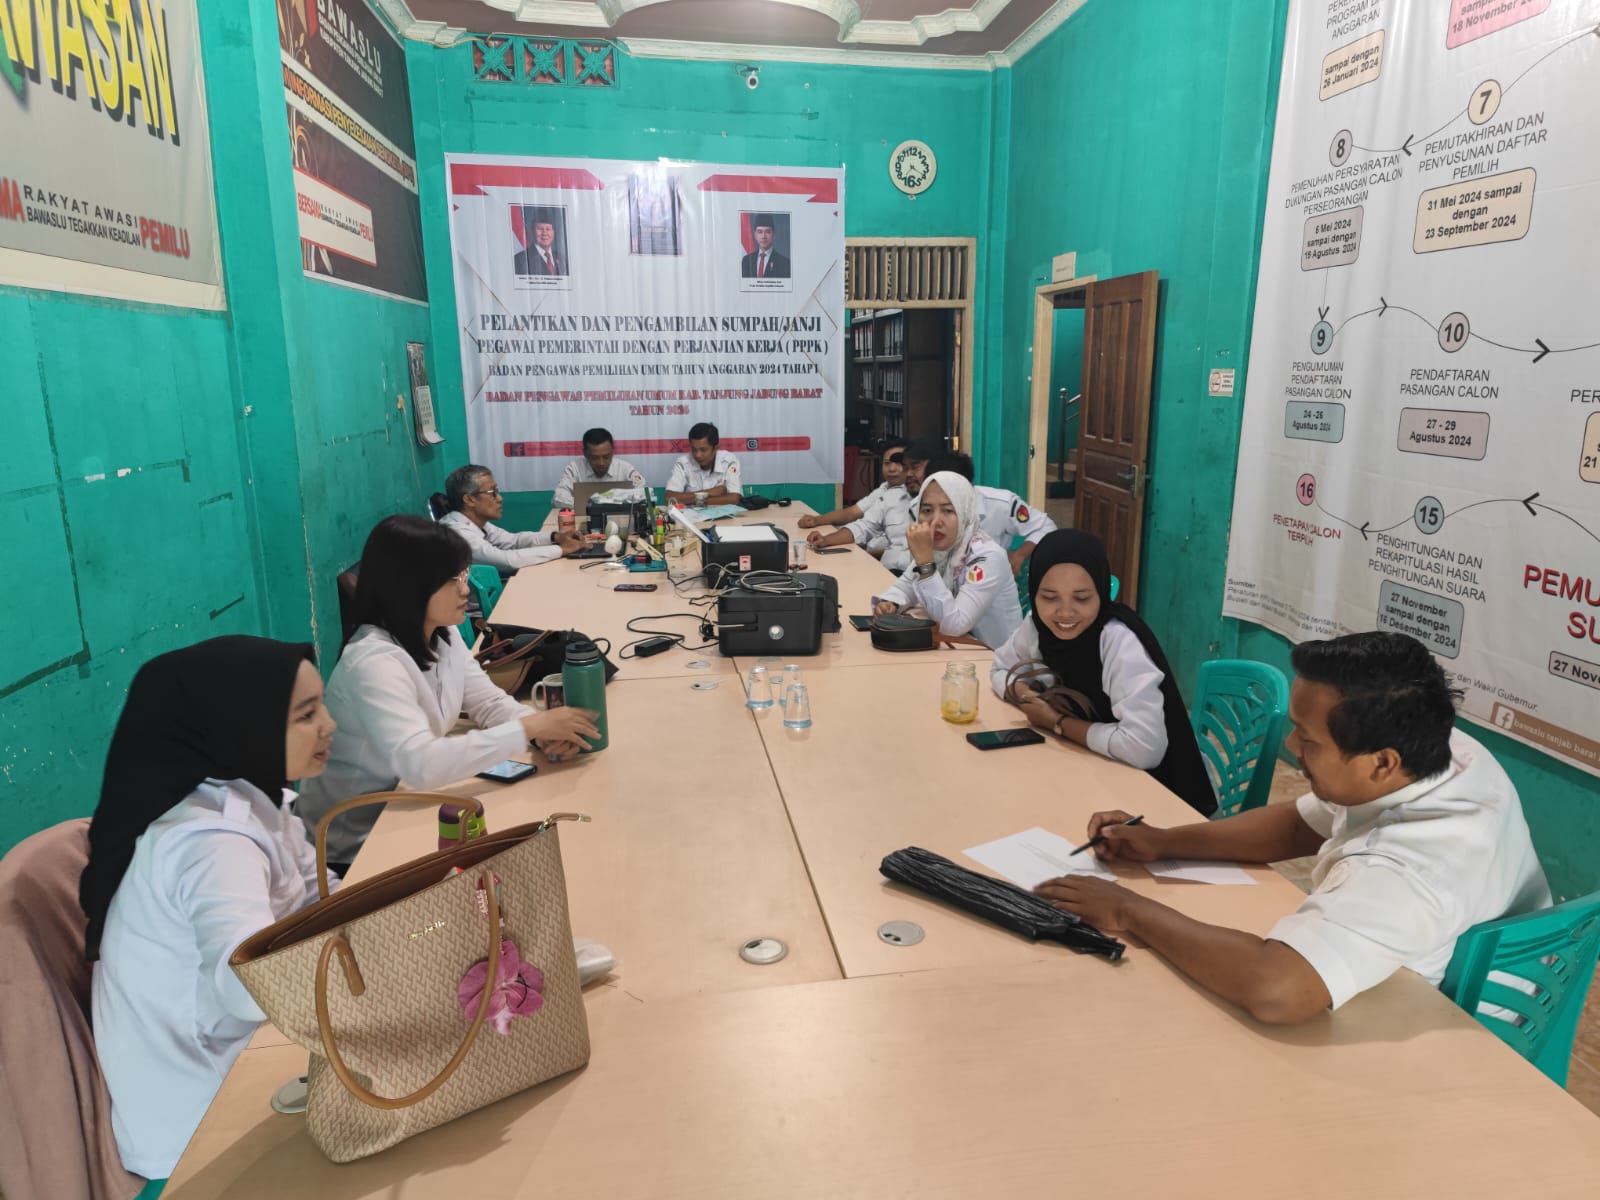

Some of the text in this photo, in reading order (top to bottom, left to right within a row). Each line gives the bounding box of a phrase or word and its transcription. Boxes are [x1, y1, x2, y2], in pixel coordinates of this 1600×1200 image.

[1332, 8, 1380, 40] ANGGARAN
[1452, 23, 1463, 33] 18
[1465, 0, 1517, 28] November
[1325, 46, 1380, 75] sampai dengan
[1332, 65, 1359, 85] Januari
[1360, 57, 1379, 73] 2024
[1480, 89, 1492, 115] 7
[1425, 111, 1545, 155] PEMUTAKHIRAN DAN
[1336, 138, 1346, 158] 8
[1419, 129, 1548, 173] PENYUSUNAN DAFTAR
[1291, 153, 1400, 194] PEMENUHAN PERSYARATAN
[1453, 158, 1499, 180] PEMILIH
[1285, 167, 1403, 208] DUKUNGAN PASANGAN CALON
[1427, 182, 1522, 211] 31 Mei 2024 sampai
[23, 184, 138, 228] RAKYAT AWASI
[1303, 190, 1368, 215] PERSEORANGAN
[1452, 206, 1488, 220] dengan
[27, 206, 141, 246] BAWASLU TEGAKKAN KEADILAN
[1321, 222, 1333, 233] Mei
[1334, 218, 1352, 230] 2024
[1425, 214, 1516, 239] 23 September 2024
[139, 216, 190, 259] PEMILU
[1307, 232, 1356, 247] sampai dengan
[1312, 247, 1340, 260] Agustus
[480, 314, 821, 332] PELANTIKAN DAN PENGAMBILAN SUMPAH/JANJI
[1316, 322, 1464, 347] 9 10
[478, 339, 535, 353] PEGAWAI
[538, 339, 619, 353] PEMERINTAH
[622, 339, 670, 353] DENGAN
[674, 339, 745, 353] PERJANJIAN
[747, 339, 783, 353] KERJA
[488, 365, 522, 376] BADAN
[525, 365, 580, 376] PENGAWAS
[582, 364, 638, 376] PEMILIHAN
[641, 364, 669, 375] UMUM
[672, 364, 705, 375] TAHUN
[708, 364, 757, 375] ANGGARAN
[759, 363, 781, 374] 2024
[783, 363, 812, 374] TAHAP
[1292, 361, 1344, 372] PENGUMUMAN
[1410, 368, 1490, 381] PENDAFTARAN
[1291, 375, 1342, 384] PENDAFTARAN
[485, 391, 522, 402] BADAN
[524, 391, 582, 402] PENGAWAS
[584, 390, 643, 401] PEMILIHAN
[646, 390, 677, 400] UMUM
[703, 389, 748, 400] TANJUNG
[750, 389, 788, 399] JABUNG
[790, 388, 823, 399] BARAT
[1285, 387, 1351, 399] PASANGAN CALON
[1400, 383, 1499, 399] PASANGAN CALON
[629, 405, 665, 415] TAHUN
[1292, 420, 1318, 431] Agustus
[1426, 419, 1437, 429] 27
[1409, 431, 1472, 446] Agustus 2024
[1583, 456, 1597, 468] 21
[1300, 481, 1314, 498] 16
[1420, 505, 1439, 525] 15
[1377, 533, 1483, 569] PENGHITUNGAN DAN
[1376, 547, 1479, 585] REKAPITULASI HASIL
[1368, 558, 1486, 603] PENGHITUNGAN SUARA
[1523, 564, 1600, 607] PEMU
[1391, 592, 1447, 617] 27 November
[1386, 604, 1450, 632] sampai dengan
[1389, 618, 1432, 640] Desember
[1434, 633, 1456, 648] 2024
[1553, 660, 1568, 673] 27
[1457, 673, 1471, 685] dan
[1473, 679, 1496, 694] Wakil
